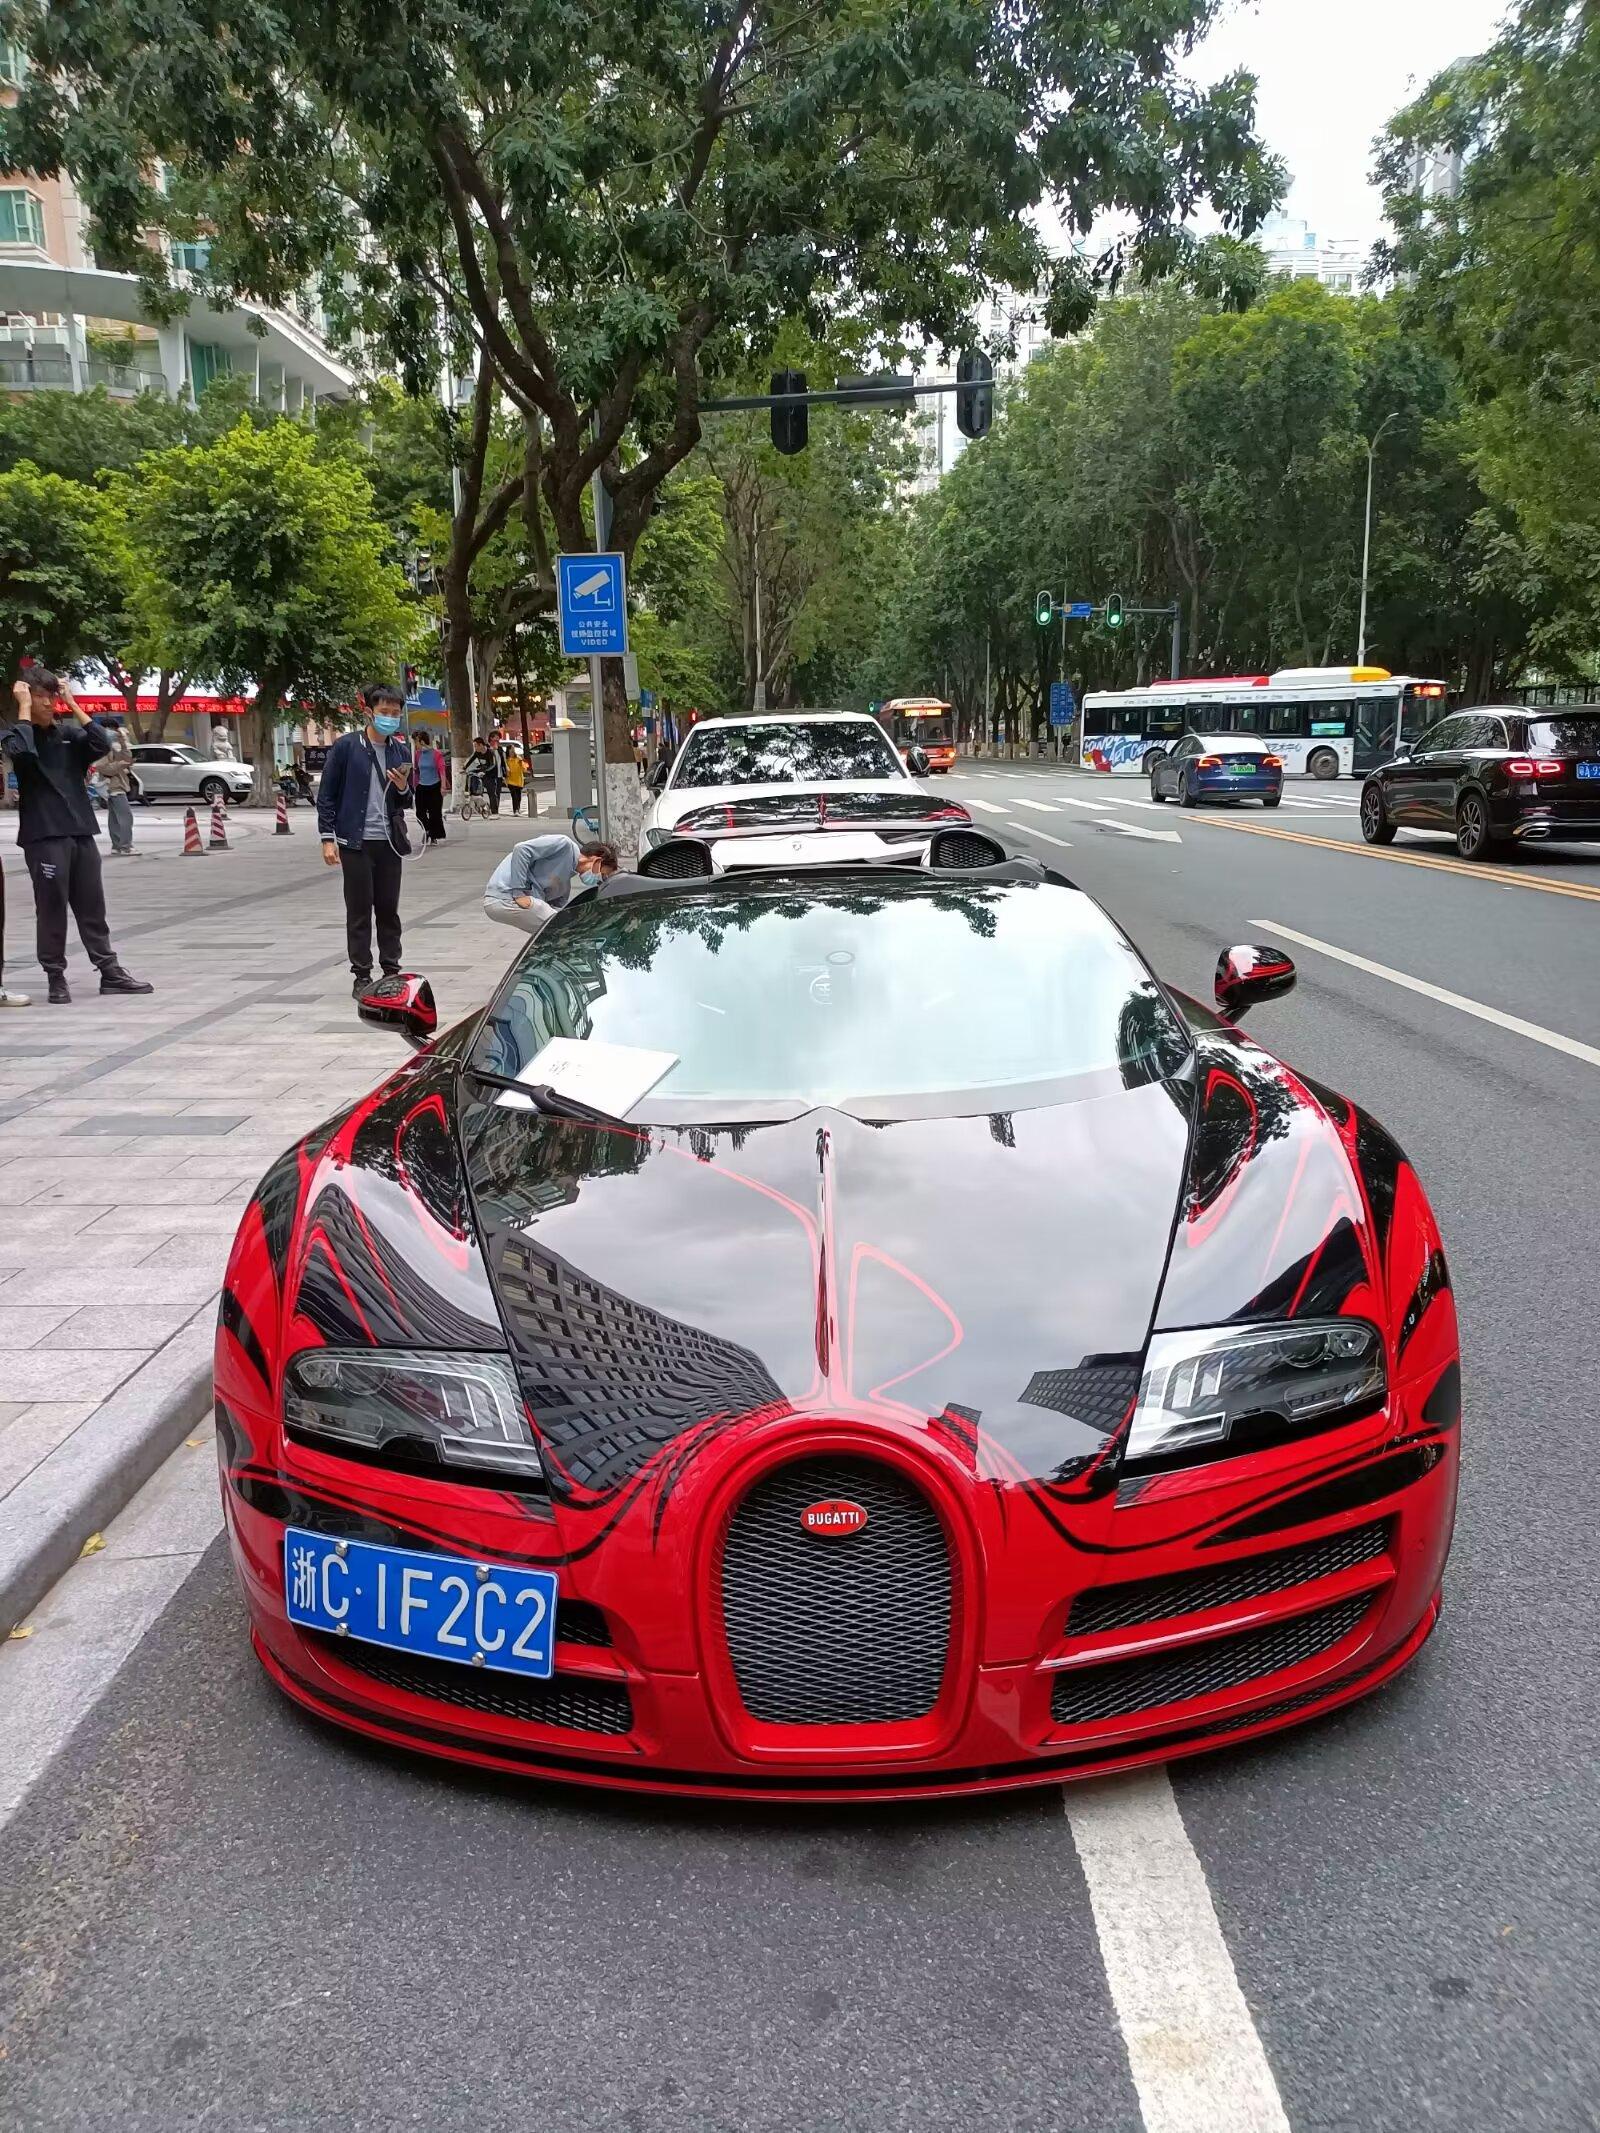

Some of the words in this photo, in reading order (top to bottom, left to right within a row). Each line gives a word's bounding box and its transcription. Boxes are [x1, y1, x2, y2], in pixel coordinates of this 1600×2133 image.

[578, 620, 609, 628] 公共安全
[581, 638, 608, 646] VIDEO
[808, 1511, 860, 1526] BUGATTI
